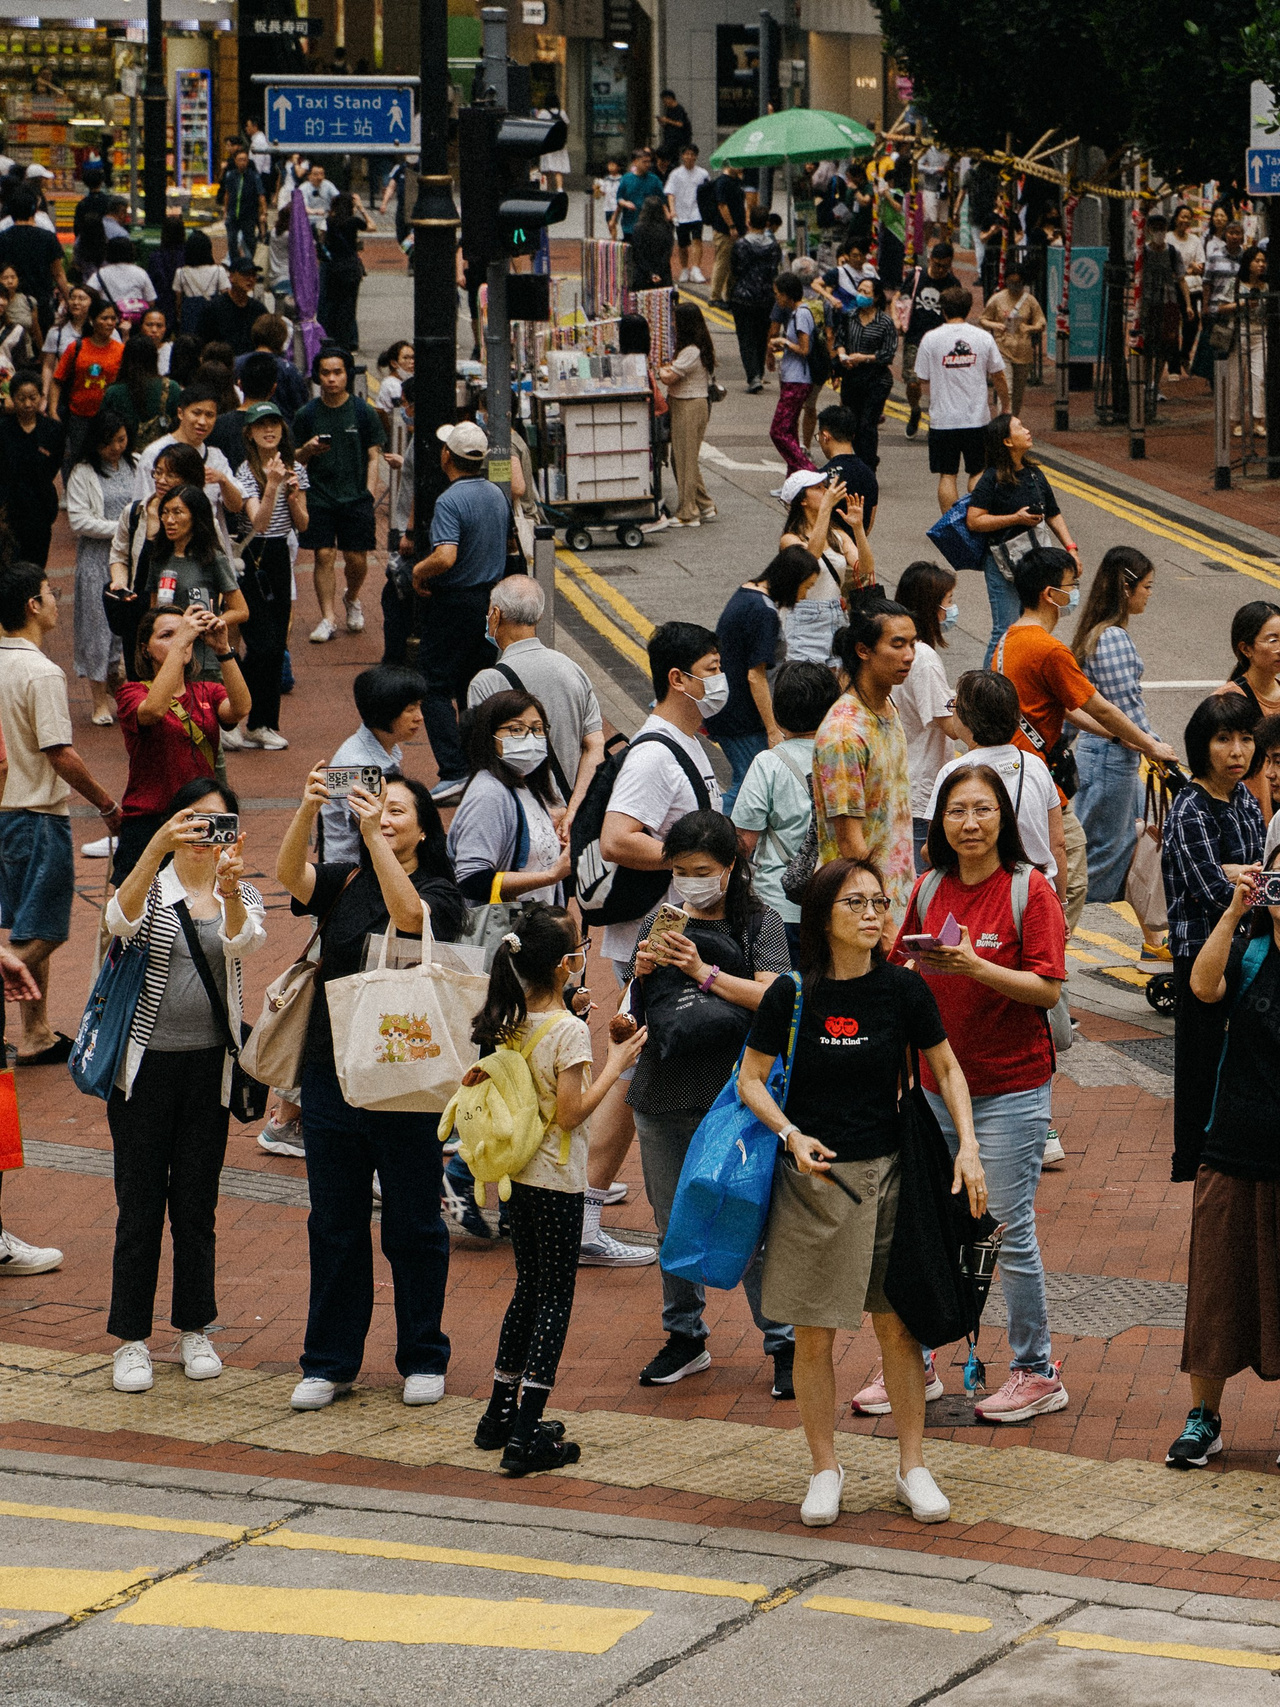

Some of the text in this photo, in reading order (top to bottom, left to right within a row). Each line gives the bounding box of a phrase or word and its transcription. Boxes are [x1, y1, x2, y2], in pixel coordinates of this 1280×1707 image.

[296, 95, 381, 109] Taxi Stand
[305, 117, 372, 136] 的士站
[981, 932, 998, 941] BUGS
[975, 939, 1002, 950] BUNNY
[819, 1036, 830, 1045] To
[830, 1037, 841, 1046] Be
[842, 1037, 861, 1046] Kind
